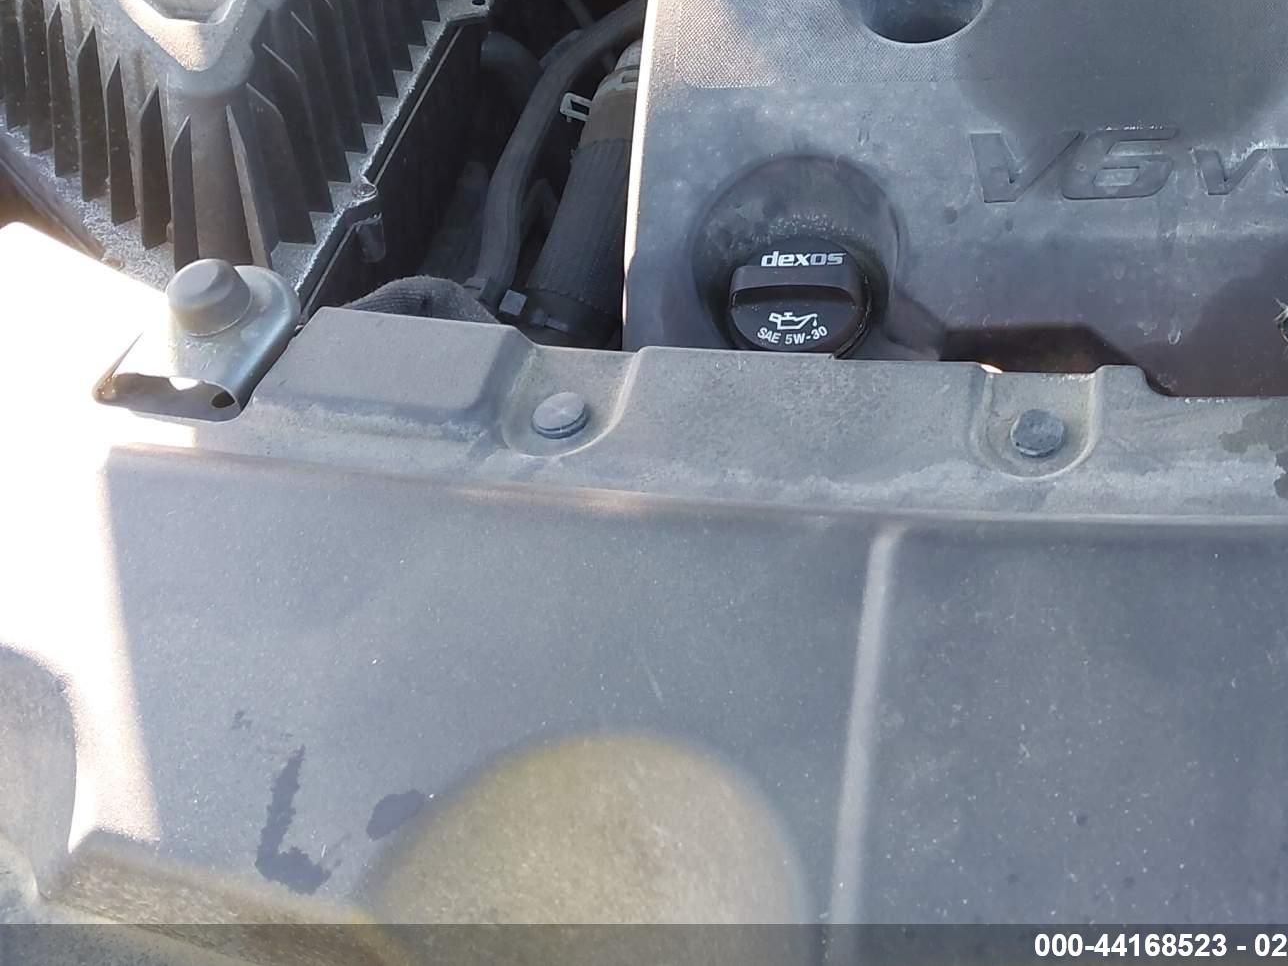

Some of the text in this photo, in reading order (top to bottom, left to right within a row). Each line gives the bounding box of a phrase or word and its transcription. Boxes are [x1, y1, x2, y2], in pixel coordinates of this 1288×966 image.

[970, 127, 1180, 202] V6
[761, 251, 847, 267] dexos
[757, 326, 828, 344] SAE 5W-30
